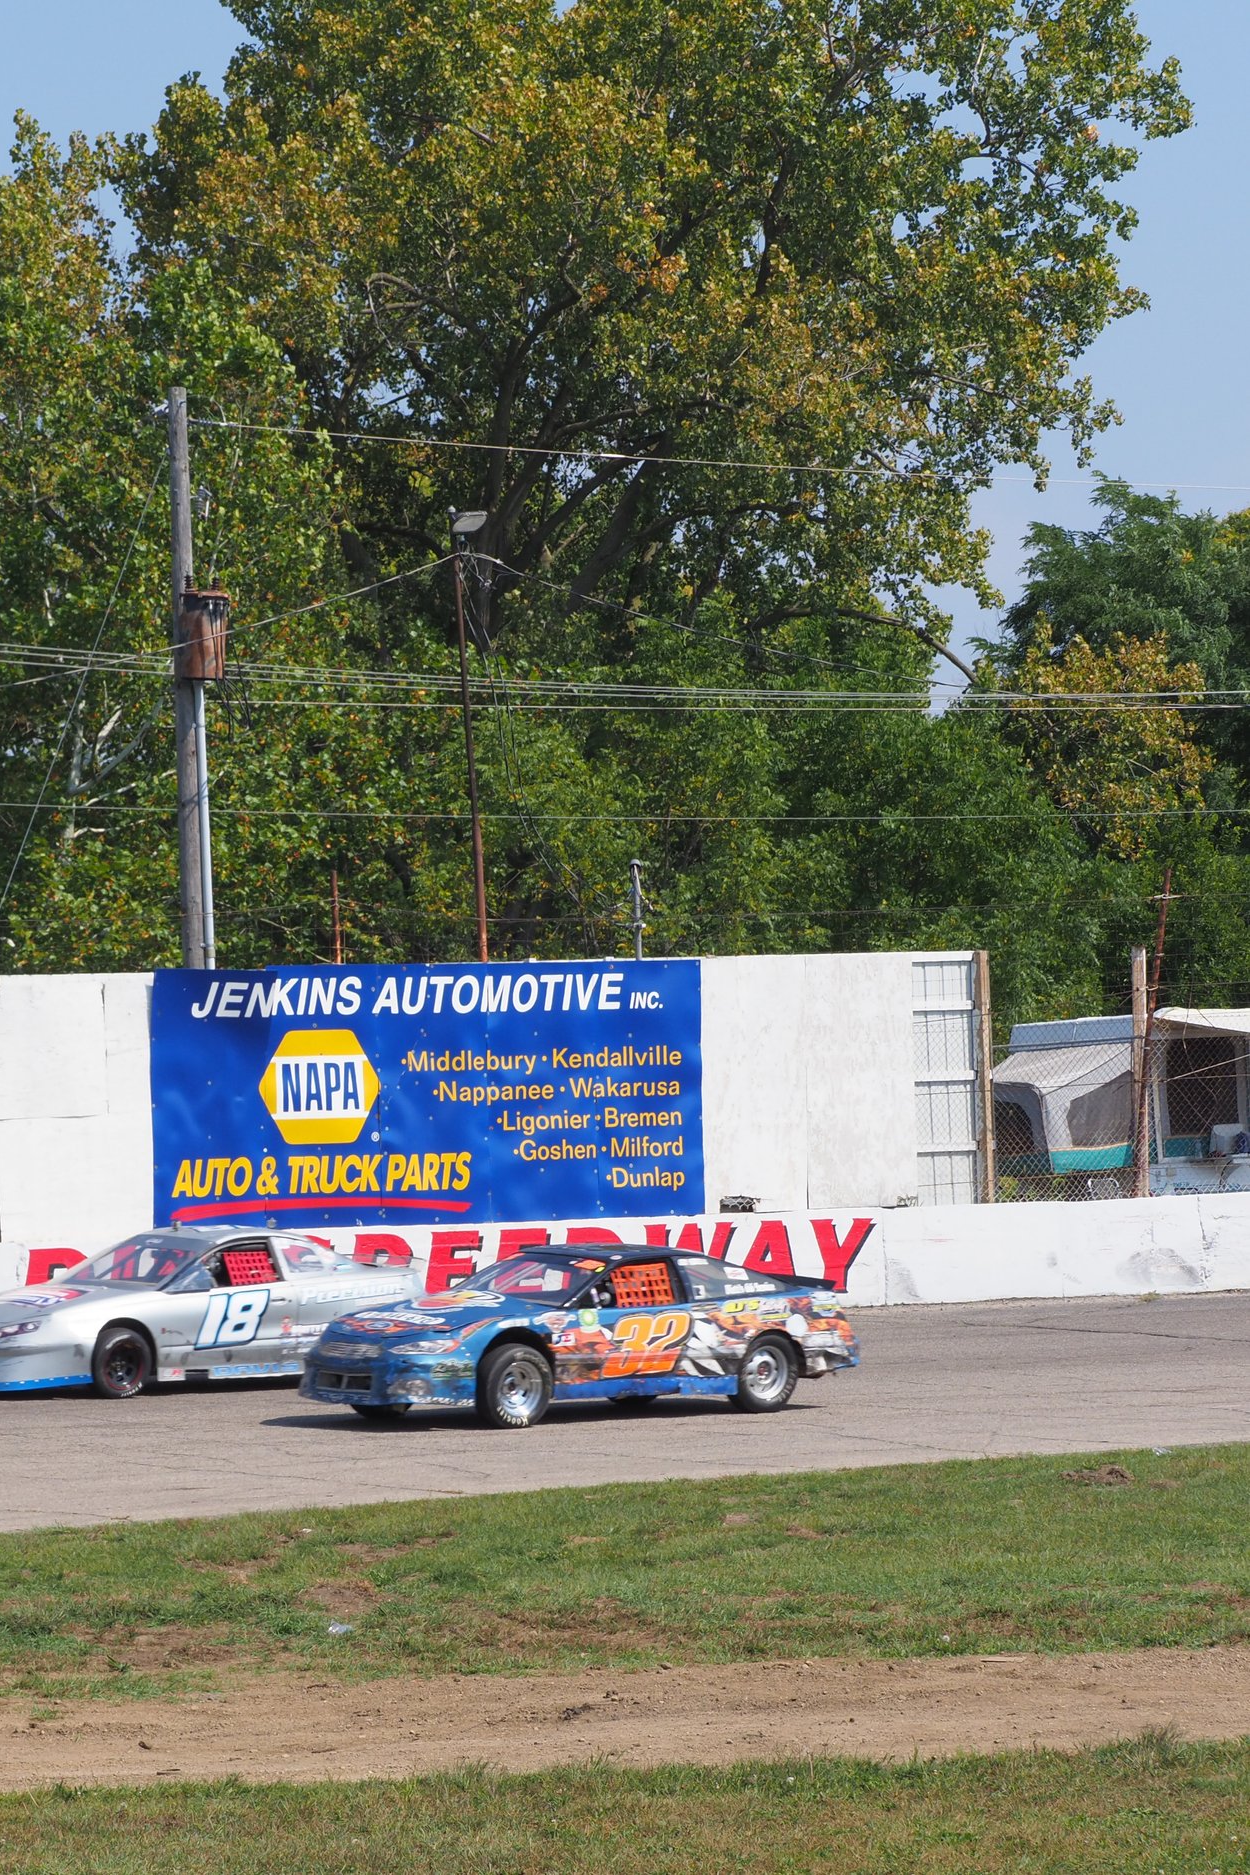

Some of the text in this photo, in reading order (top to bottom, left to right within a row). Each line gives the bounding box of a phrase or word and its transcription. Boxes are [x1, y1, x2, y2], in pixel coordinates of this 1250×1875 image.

[191, 973, 664, 1019] JENKINS AUTOMOTIVE INC.
[407, 1045, 682, 1075] Middlebury Kendallville
[282, 1061, 360, 1112] NAPA
[439, 1076, 680, 1106] Nappanee Wakarusa
[502, 1107, 682, 1135] Ligonier Bremen
[519, 1135, 683, 1161] Goshen Milford
[172, 1151, 472, 1198] AUTO & TRUCK PARTS
[611, 1167, 685, 1191] Dunlap
[195, 1289, 270, 1350] 18
[602, 1310, 694, 1379] 32
